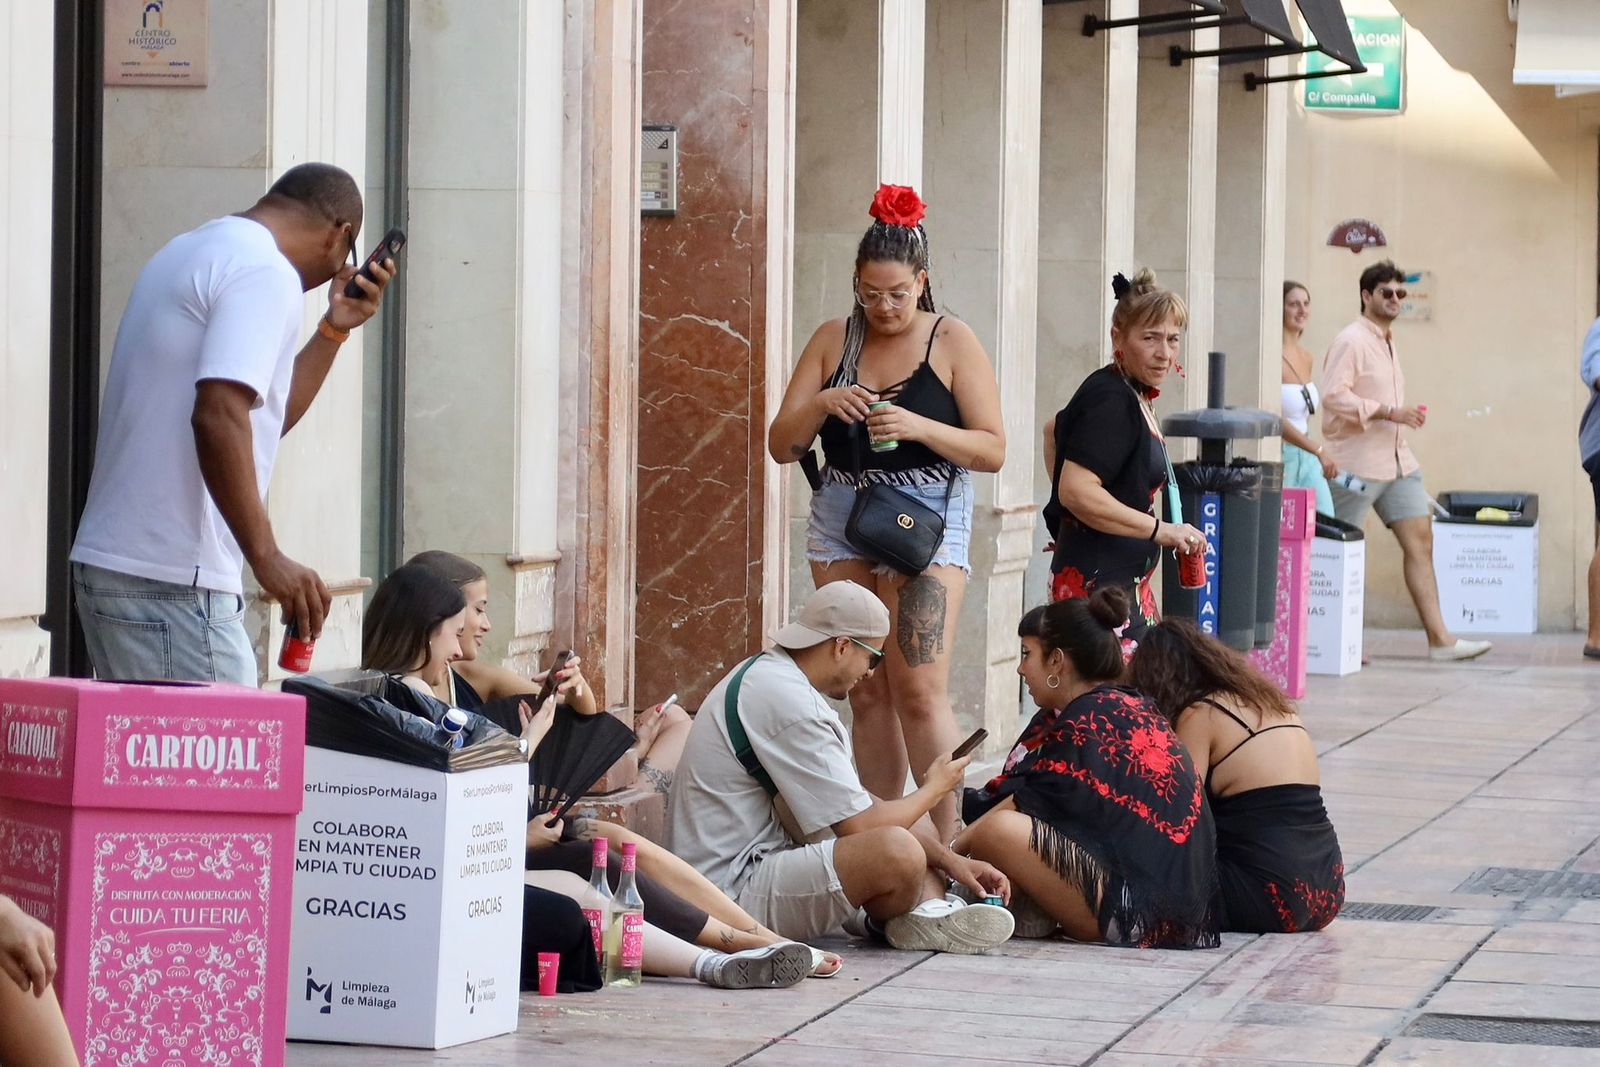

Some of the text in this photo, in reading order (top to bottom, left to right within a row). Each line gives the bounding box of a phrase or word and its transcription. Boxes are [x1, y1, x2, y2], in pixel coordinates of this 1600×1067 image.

[135, 29, 171, 37] CENTRO
[1201, 502, 1217, 634] GRACIAS
[7, 721, 57, 762] CARTOJAL
[125, 732, 261, 775] CARTOJAL
[304, 781, 438, 803] erLimpiosPorMálaga
[313, 820, 408, 840] COLABORA
[471, 821, 504, 838] COLABORA
[298, 839, 421, 860] EN MANTENER
[466, 838, 508, 858] EN MANTENER
[295, 858, 437, 881] MPIA TU CIUDAD
[459, 856, 512, 879] LIMPIA TU CIUDAD
[111, 887, 252, 900] DISFRUTA CON MODERACIÓN
[109, 907, 251, 925] CUIDA TU FERIA
[305, 897, 407, 921] GRACIAS
[468, 896, 503, 919] GRACIAS
[342, 980, 390, 994] Limpieza
[341, 995, 397, 1010] de Málaga
